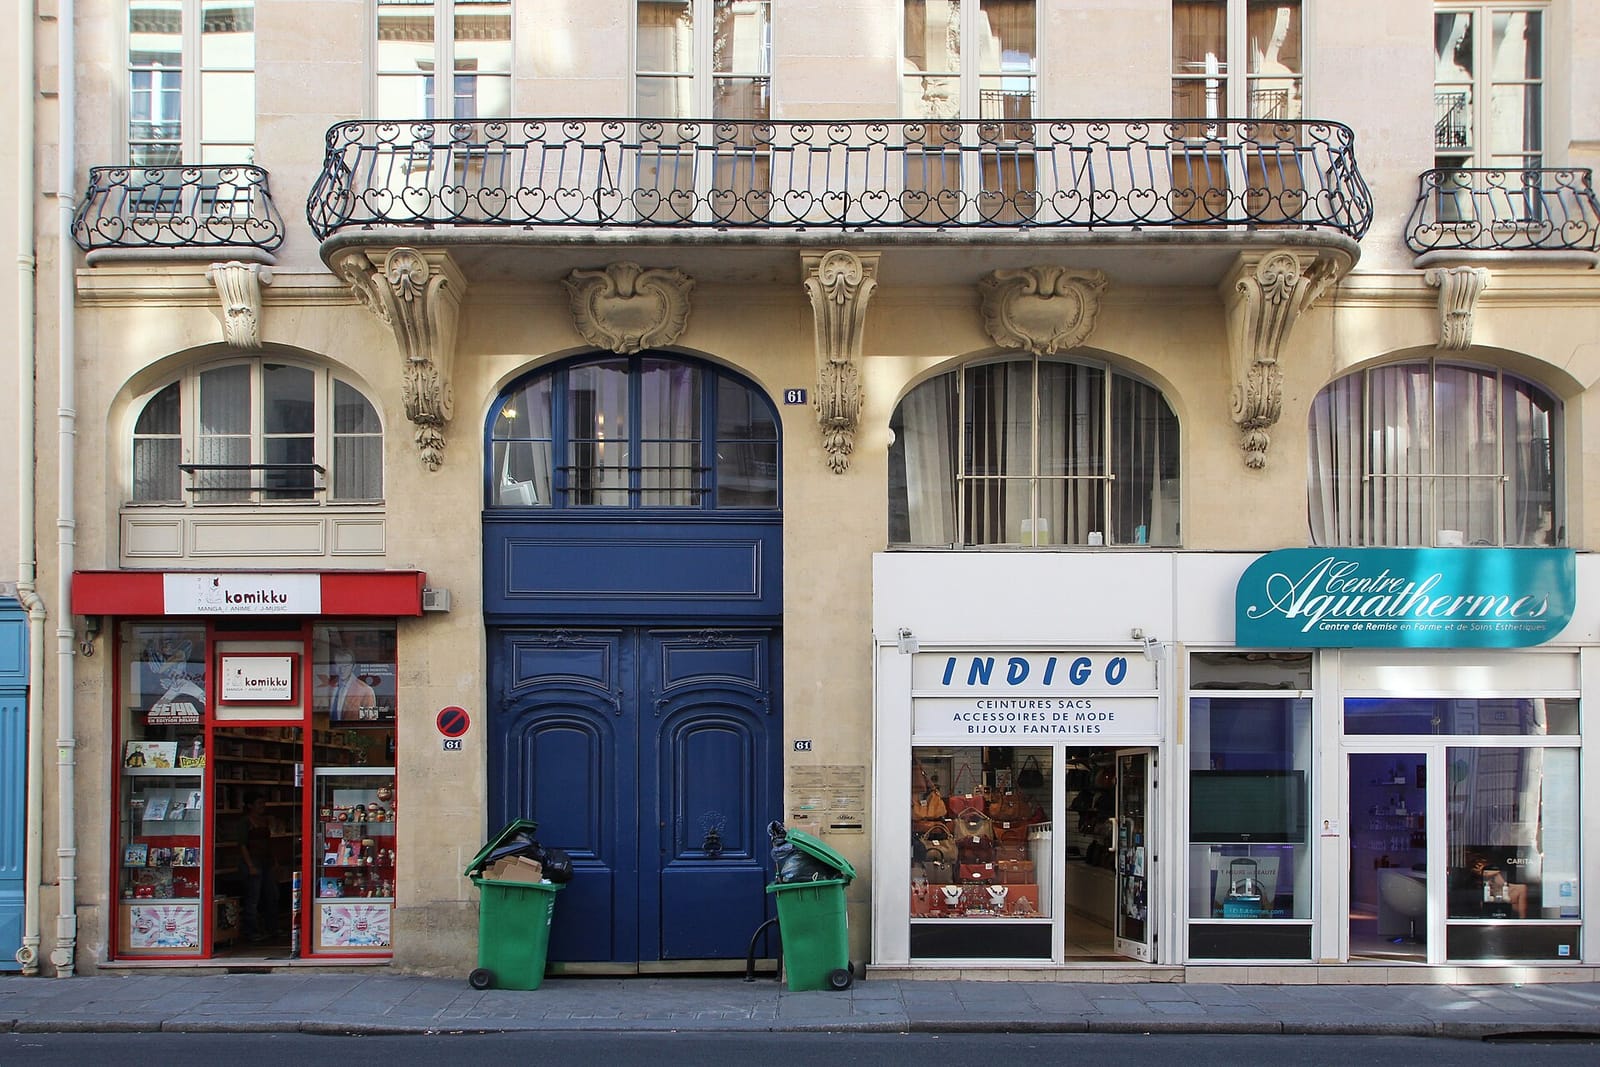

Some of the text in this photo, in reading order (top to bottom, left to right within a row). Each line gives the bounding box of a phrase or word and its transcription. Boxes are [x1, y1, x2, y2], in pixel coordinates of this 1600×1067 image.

[787, 390, 802, 403] 61
[1325, 561, 1405, 593] Centre
[225, 590, 287, 604] komikku
[1247, 557, 1550, 632] Aquathermes
[1319, 622, 1349, 631] Centre
[1352, 622, 1363, 631] de
[1366, 622, 1397, 631] Remise
[1414, 622, 1442, 631] Forme
[1445, 623, 1454, 631] et
[1457, 622, 1467, 631] de
[1470, 622, 1492, 631] Soins
[942, 657, 1127, 686] INDIGO
[245, 677, 288, 687] komikku
[976, 700, 1092, 709] CEINTURES SACS
[953, 712, 1115, 722] ACCESSOIRES DE MODE
[968, 725, 1101, 734] BIJOUX FANTAISIES
[446, 741, 459, 749] 61
[796, 741, 809, 750] 61
[1506, 857, 1534, 865] CARITA
